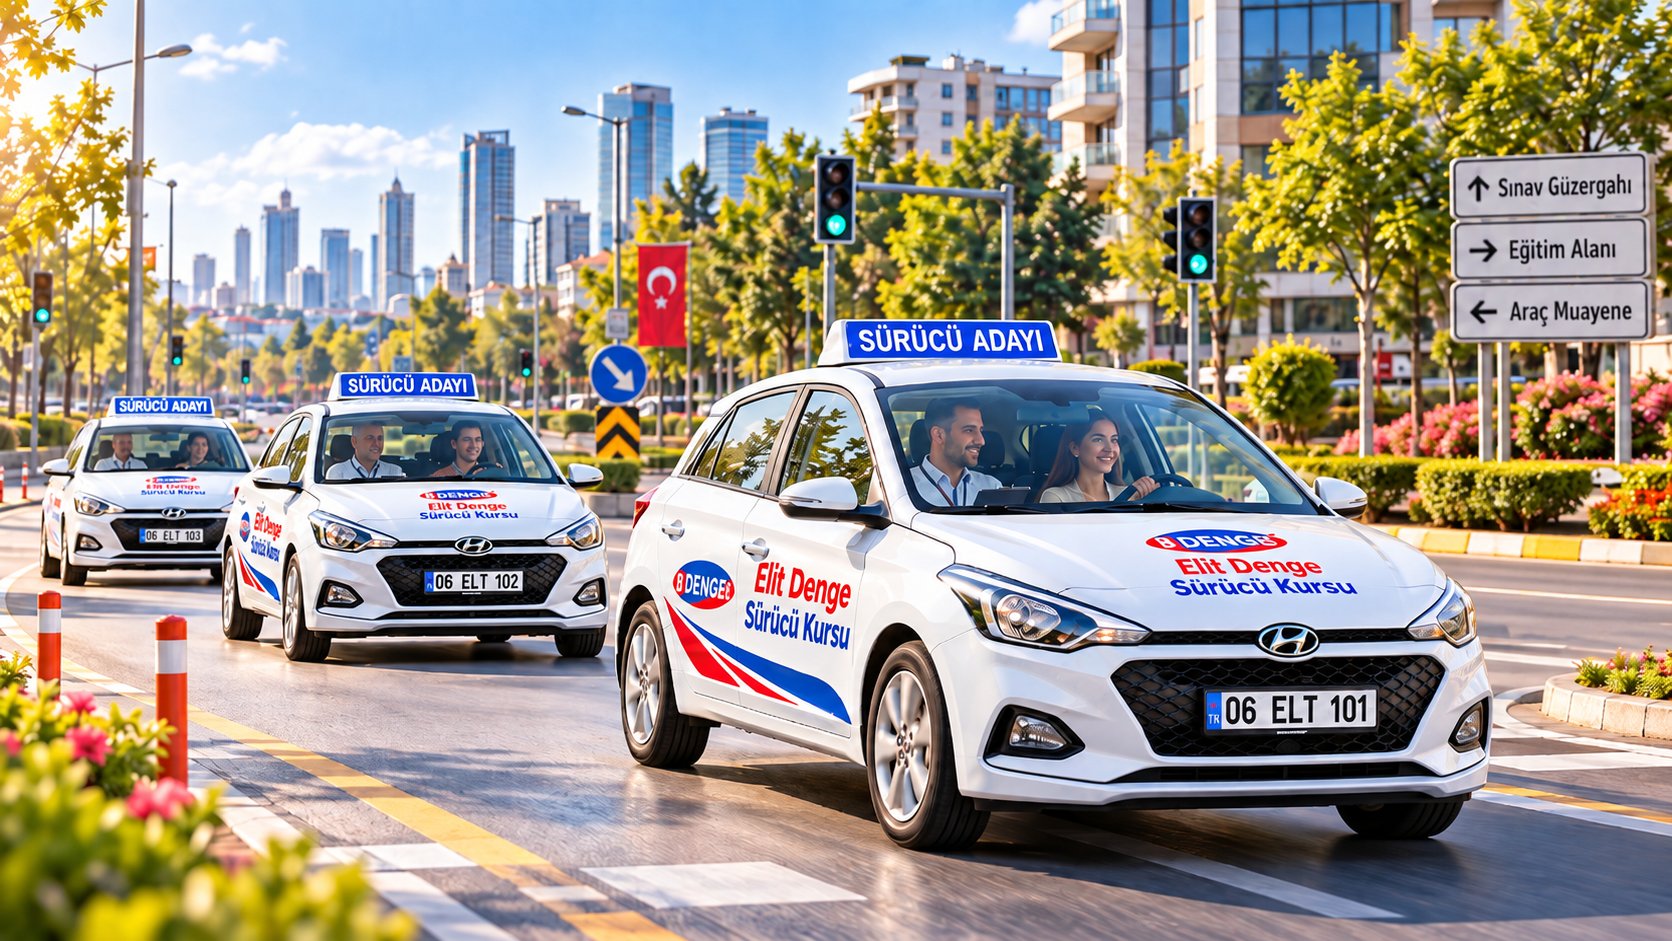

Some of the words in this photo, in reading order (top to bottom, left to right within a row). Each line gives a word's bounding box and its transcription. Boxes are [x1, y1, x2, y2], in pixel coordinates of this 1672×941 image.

[1498, 177, 1543, 197] Sınav
[1548, 174, 1632, 199] Güzergahı
[1509, 239, 1565, 264] Eğitim
[1571, 238, 1616, 259] Alanı
[1510, 301, 1548, 327] Araç
[1554, 301, 1632, 325] Muayene
[858, 323, 963, 352] SÜRÜCÜ
[973, 329, 1044, 352] ADAYI
[348, 375, 415, 393] SÜRÜCÜ
[420, 378, 467, 393] ADAYI
[119, 398, 168, 412] SÜRÜCÜ
[171, 401, 207, 412] ADAYI
[474, 511, 519, 519] Kursu
[146, 530, 158, 541] 06
[163, 530, 180, 541] ELT
[185, 530, 201, 541] 103
[1175, 558, 1227, 575] Elit
[1227, 558, 1323, 577] Denge
[435, 574, 453, 589] 06
[462, 574, 488, 589] ELT
[495, 574, 519, 589] 102
[754, 562, 786, 597] Elit
[788, 567, 852, 614] Denge
[1170, 578, 1273, 596] Sürücü
[1272, 578, 1358, 595] Kursu
[744, 600, 799, 639] Sürücü
[802, 612, 851, 650] Kursu
[1208, 714, 1220, 725] TR
[1225, 696, 1257, 725] 06
[1272, 695, 1318, 724] ELT
[1330, 695, 1367, 723] 101
